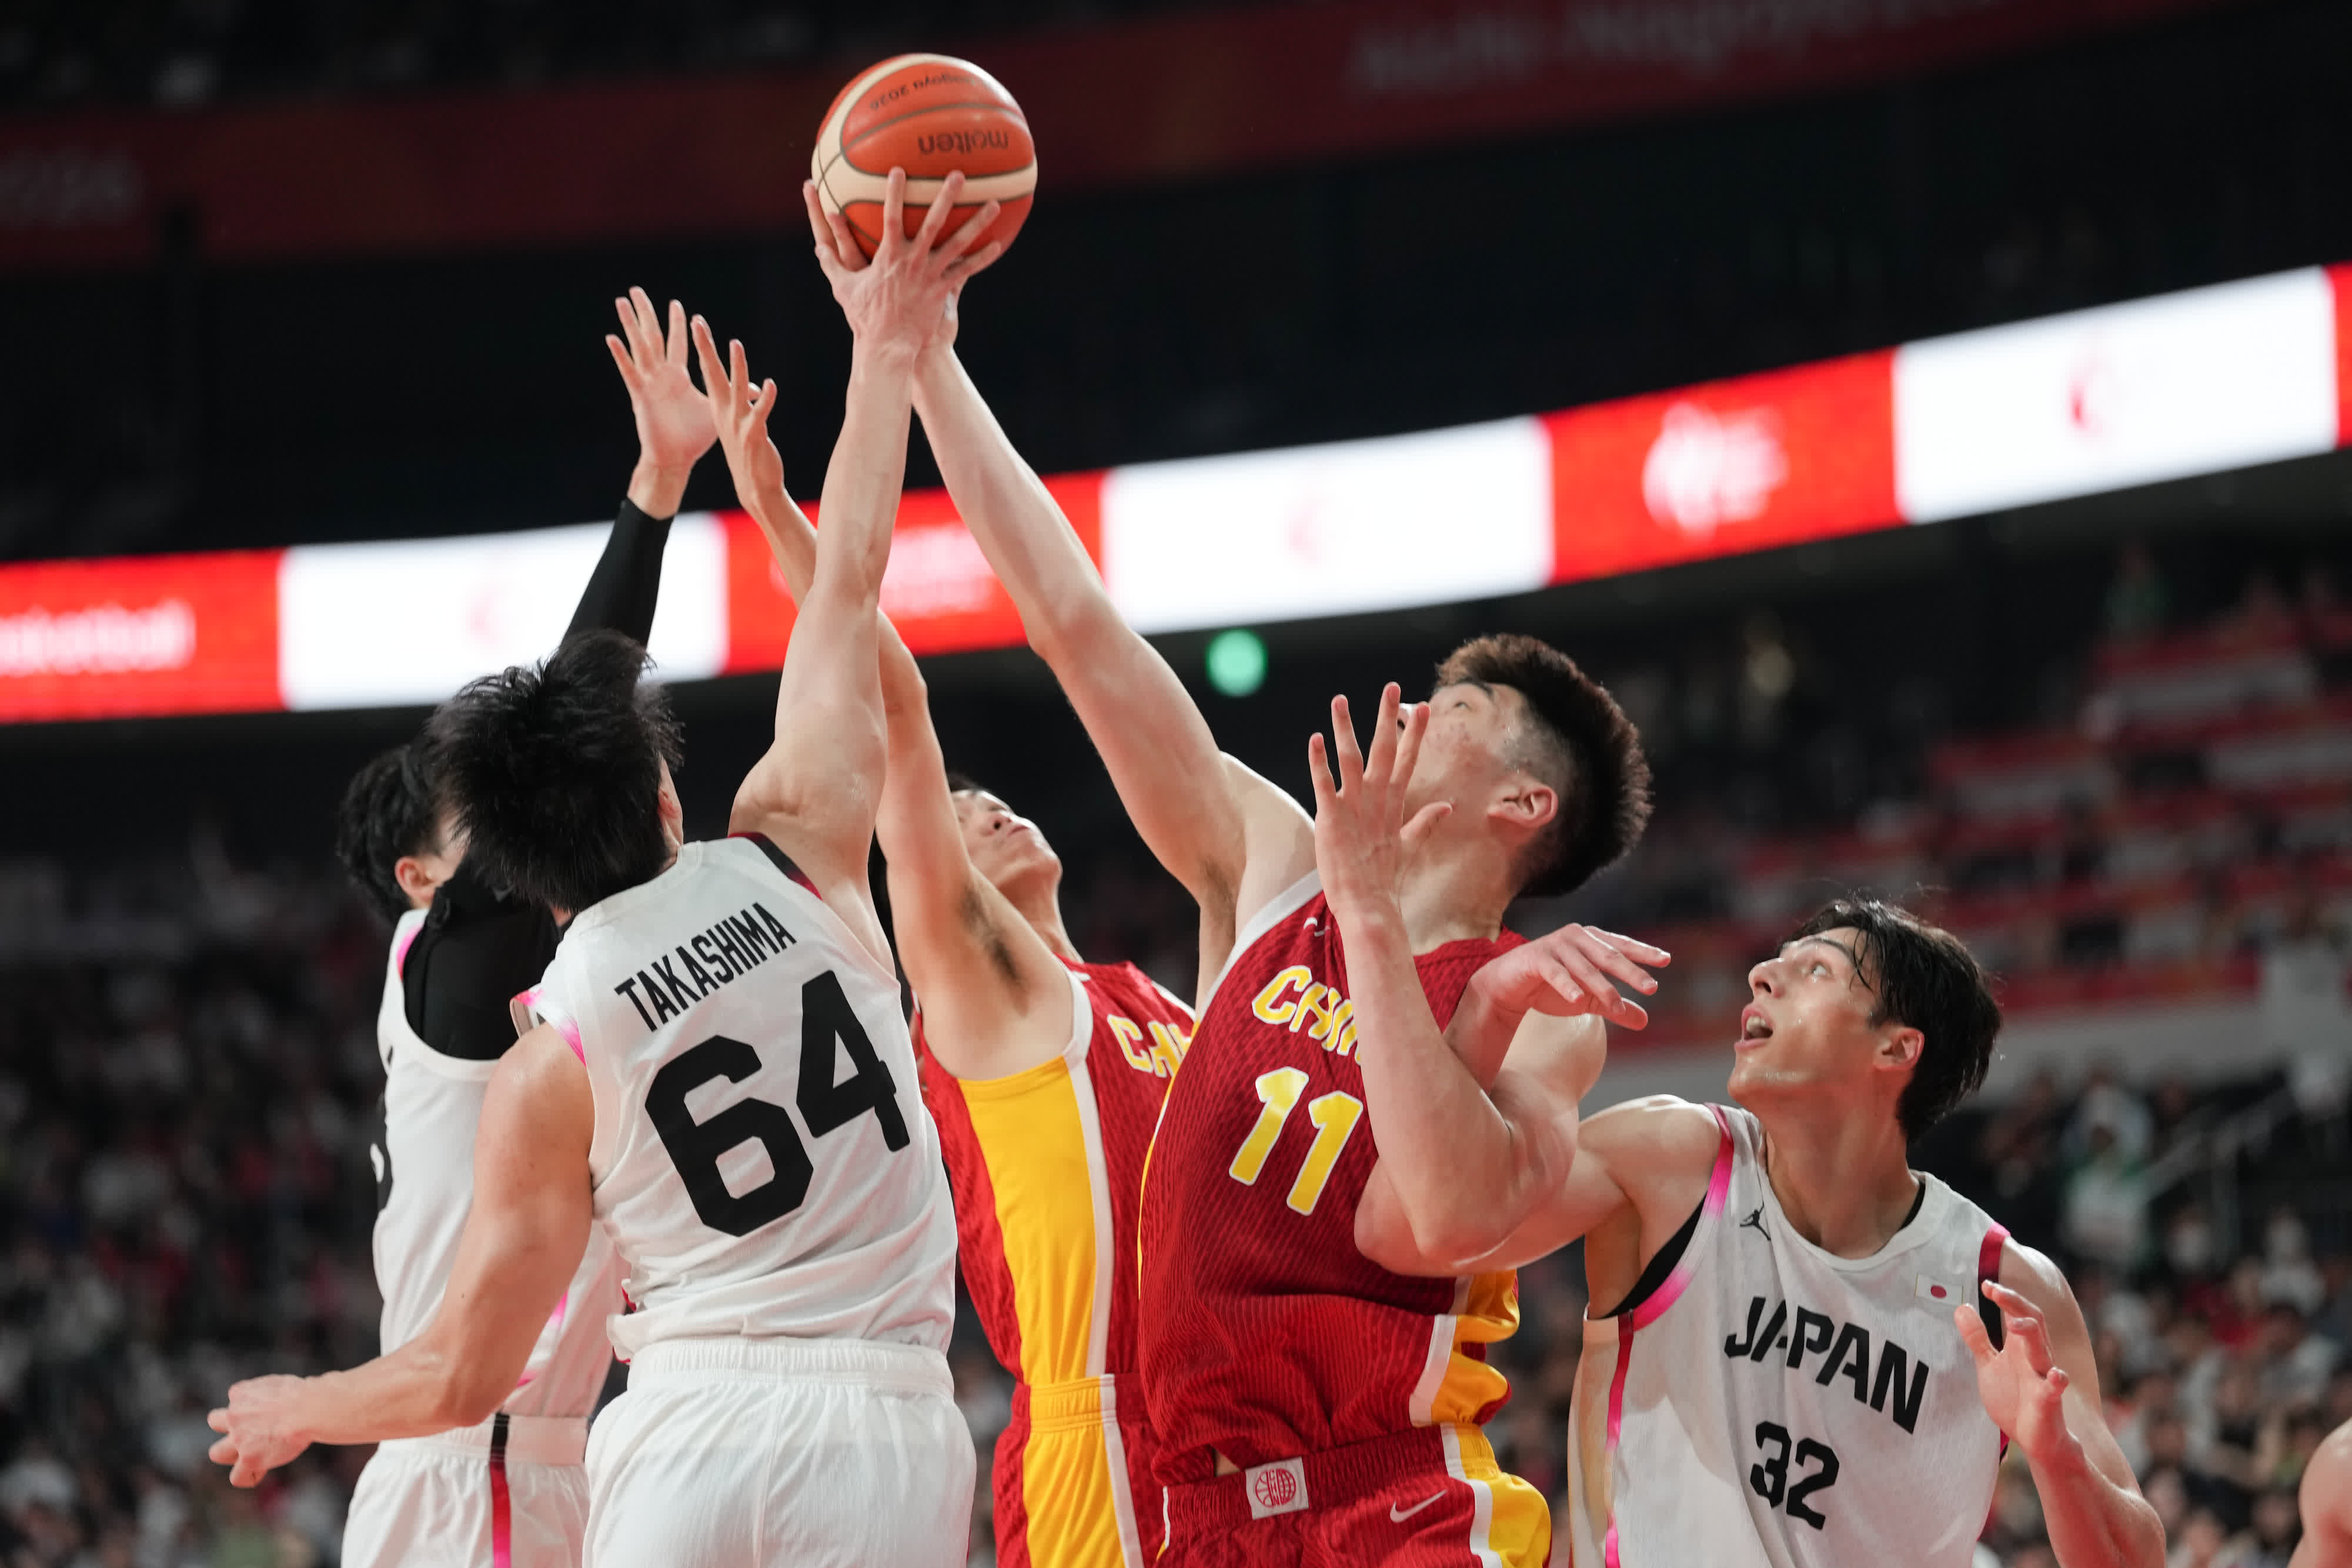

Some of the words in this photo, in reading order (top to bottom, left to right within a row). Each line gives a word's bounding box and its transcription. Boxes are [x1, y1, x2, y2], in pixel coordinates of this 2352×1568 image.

[917, 130, 1008, 155] molten
[614, 902, 797, 1032] TAKASHIMA
[644, 969, 910, 1237] 64
[1228, 1066, 1364, 1216] 11
[1723, 1296, 1930, 1435] JAPAN
[1749, 1420, 1840, 1531] 32
